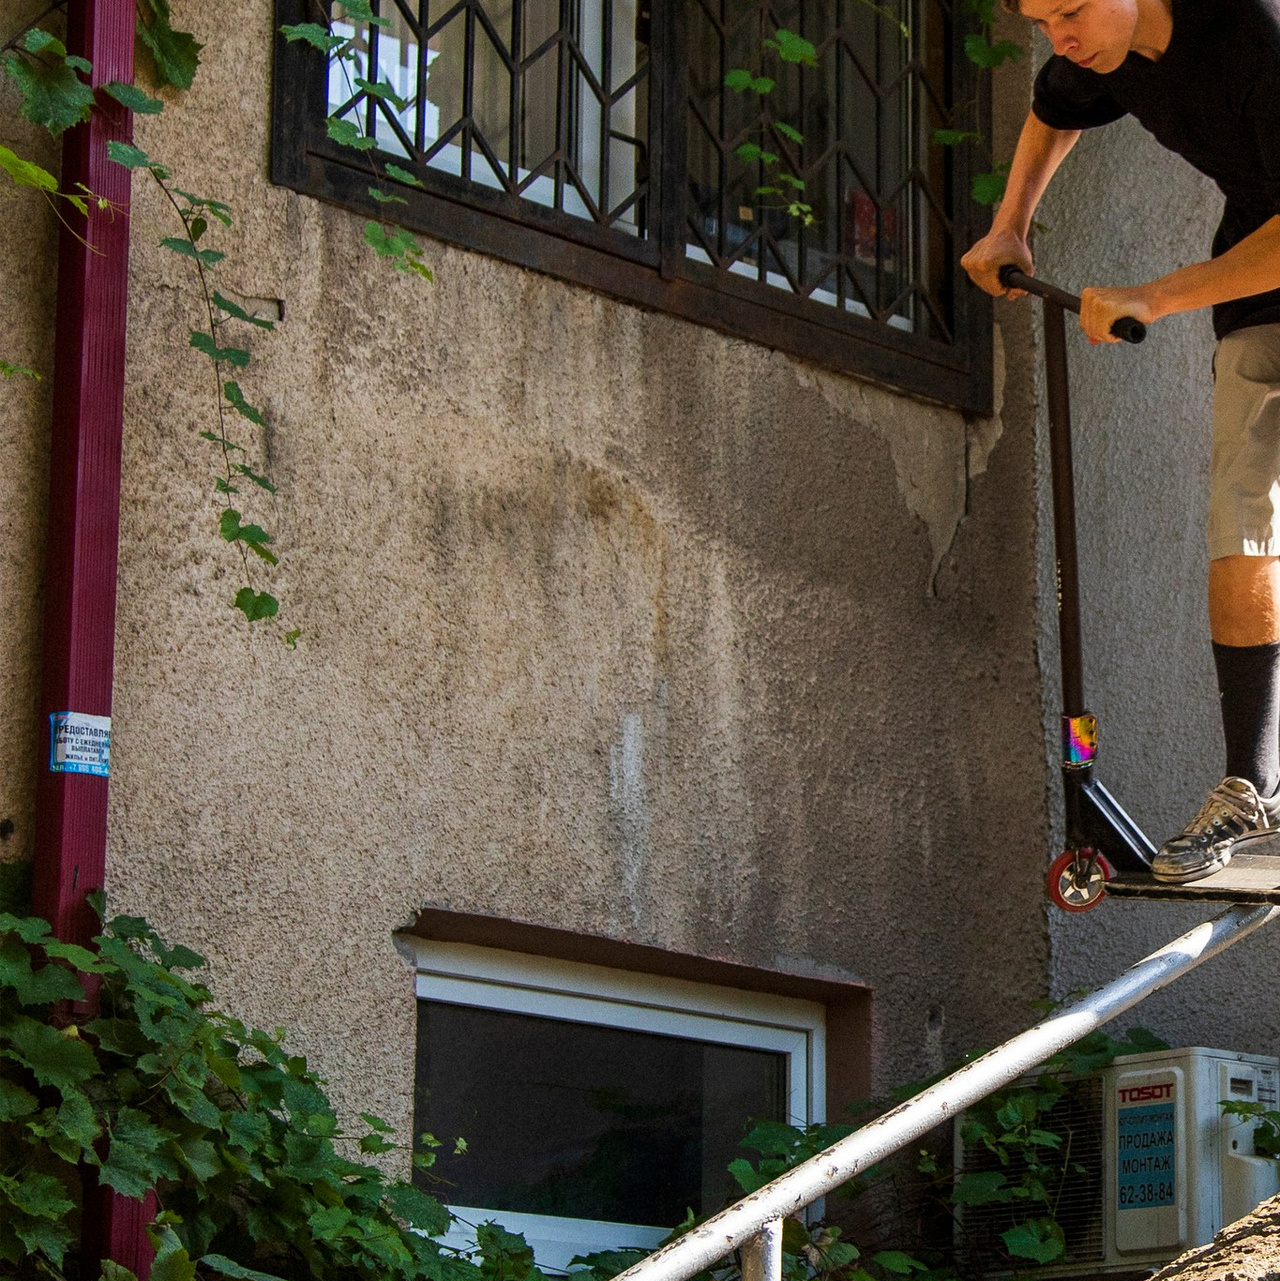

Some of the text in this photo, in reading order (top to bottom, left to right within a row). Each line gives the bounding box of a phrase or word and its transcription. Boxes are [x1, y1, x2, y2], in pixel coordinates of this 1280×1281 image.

[1118, 1083, 1174, 1102] TOSOT
[1119, 1130, 1174, 1150] ПРОДАЖА
[1122, 1155, 1171, 1174] МОНТАЖ
[1119, 1181, 1174, 1204] 62-38-84
